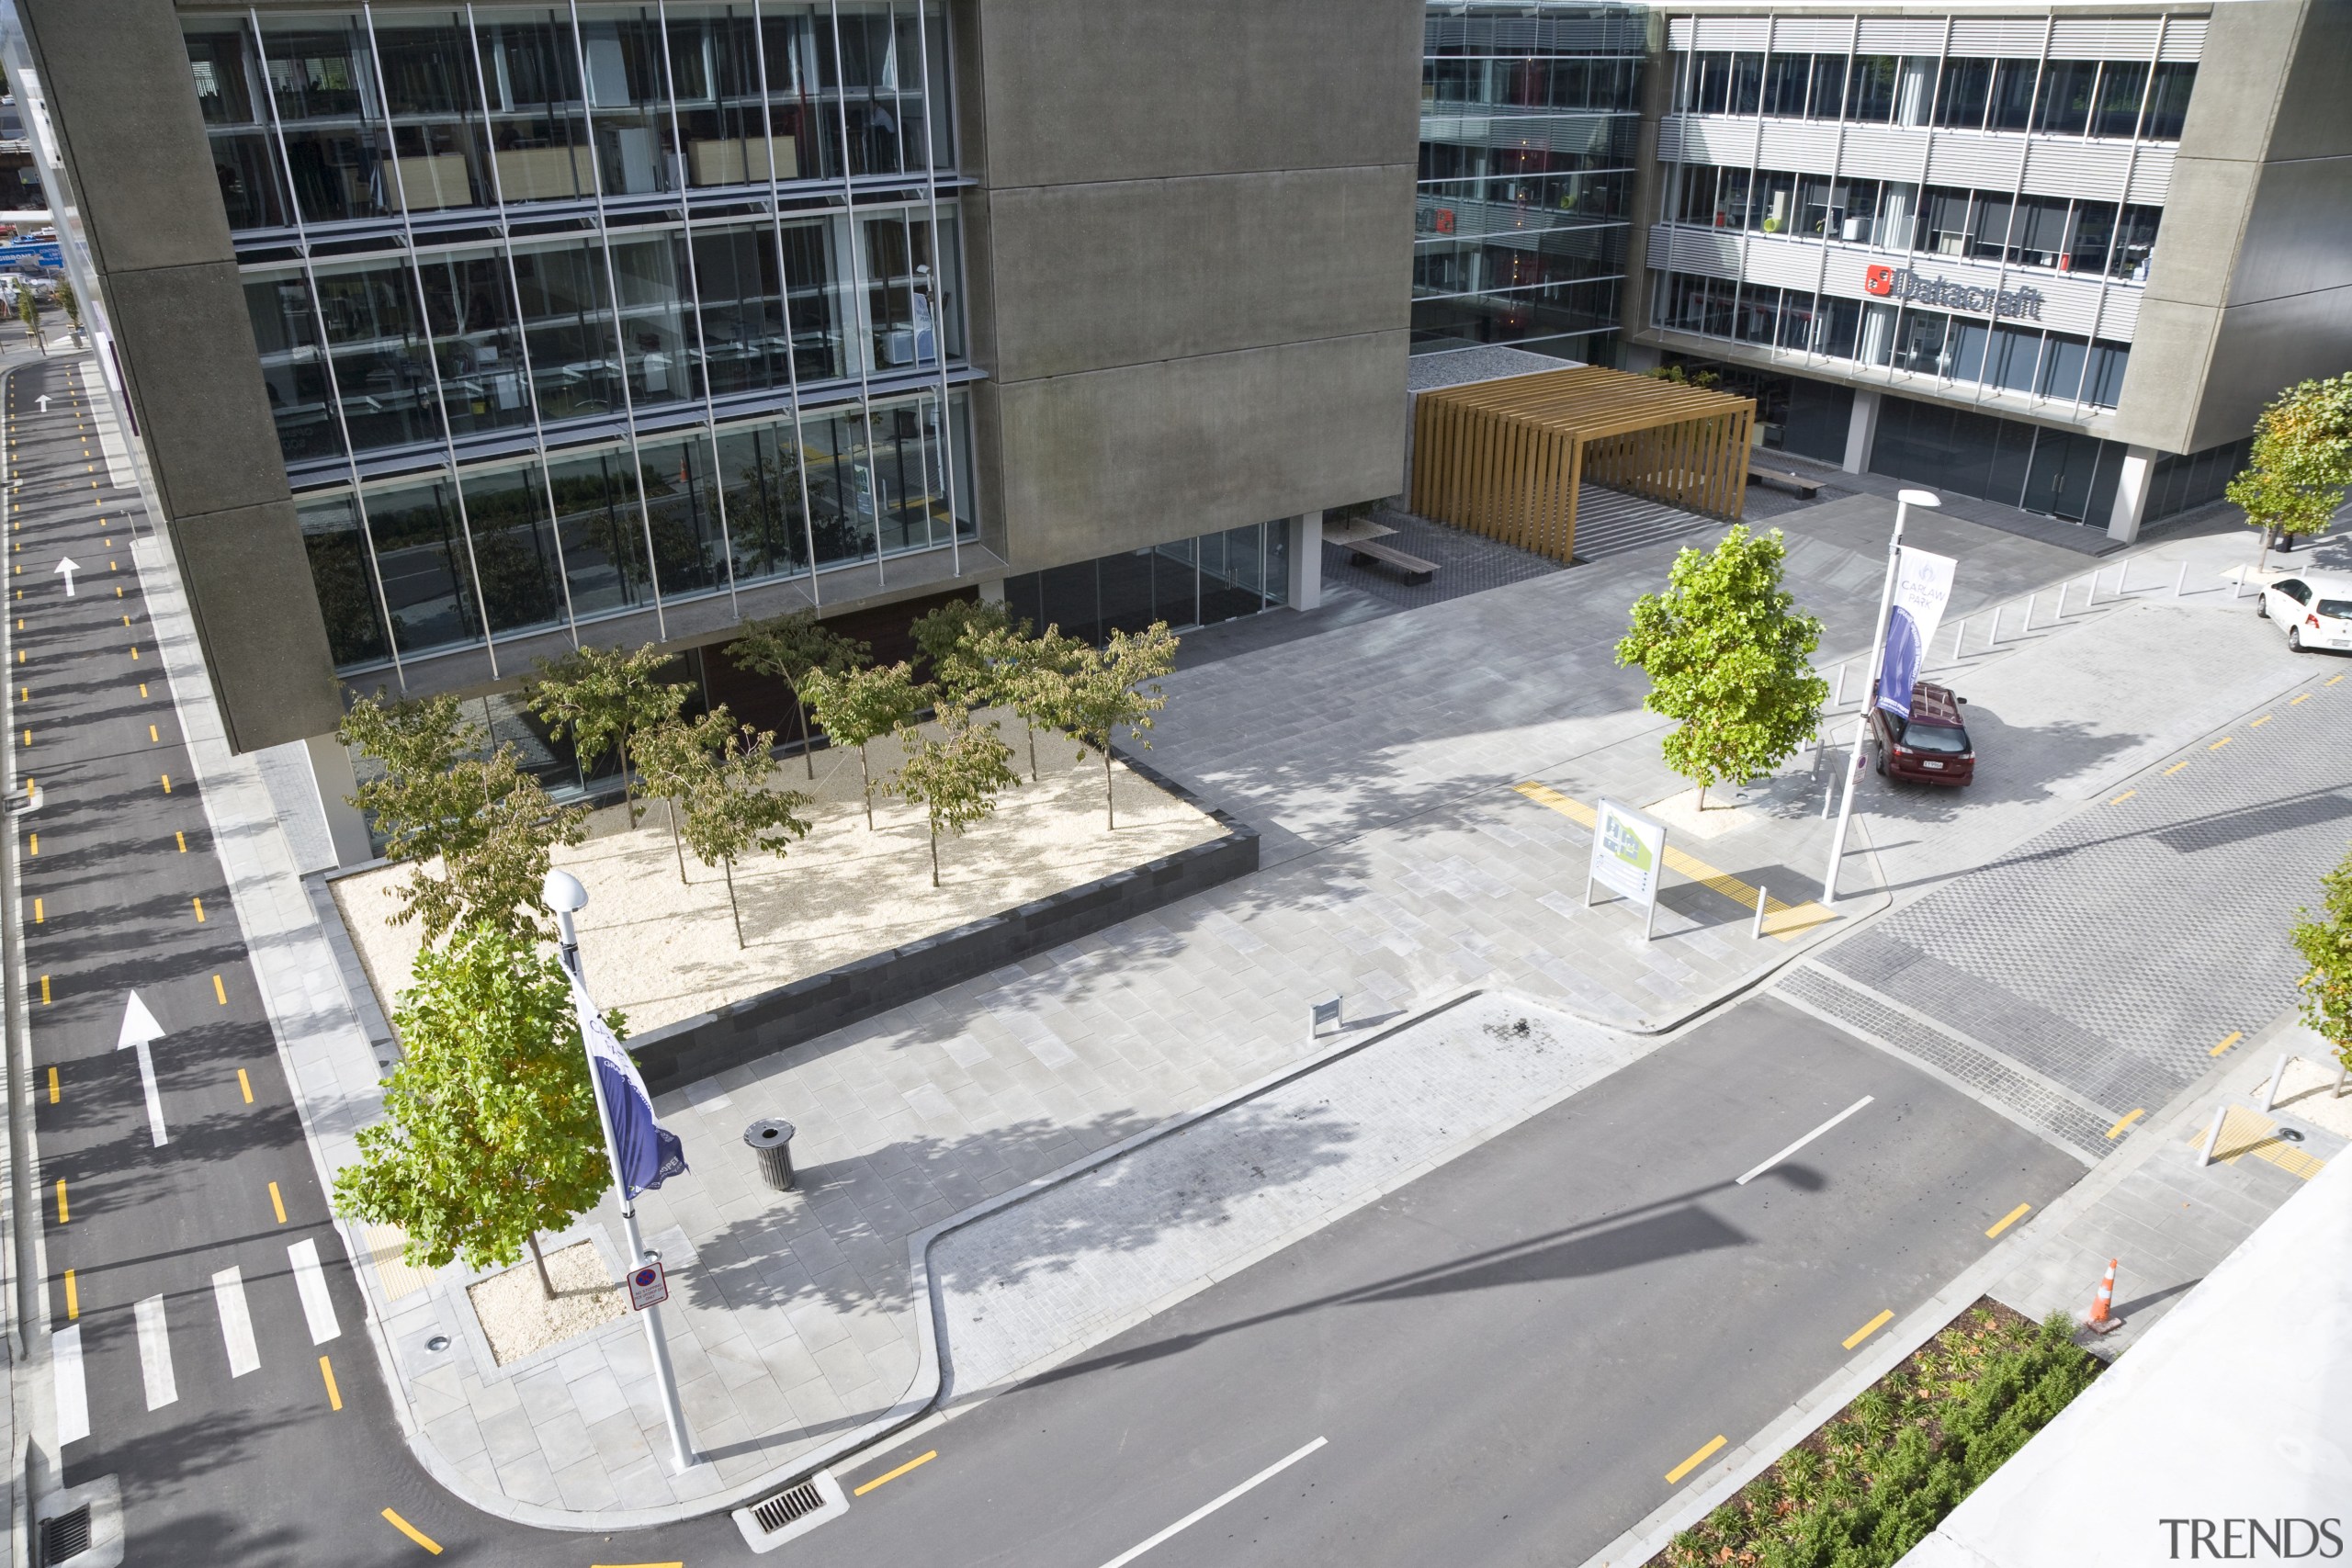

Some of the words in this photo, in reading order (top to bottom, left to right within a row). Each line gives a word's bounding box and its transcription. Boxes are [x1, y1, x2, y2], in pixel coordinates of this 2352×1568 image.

[1893, 268, 2041, 318] Datacraft
[1902, 581, 1946, 602] CARLAW
[1909, 593, 1932, 610] PARK
